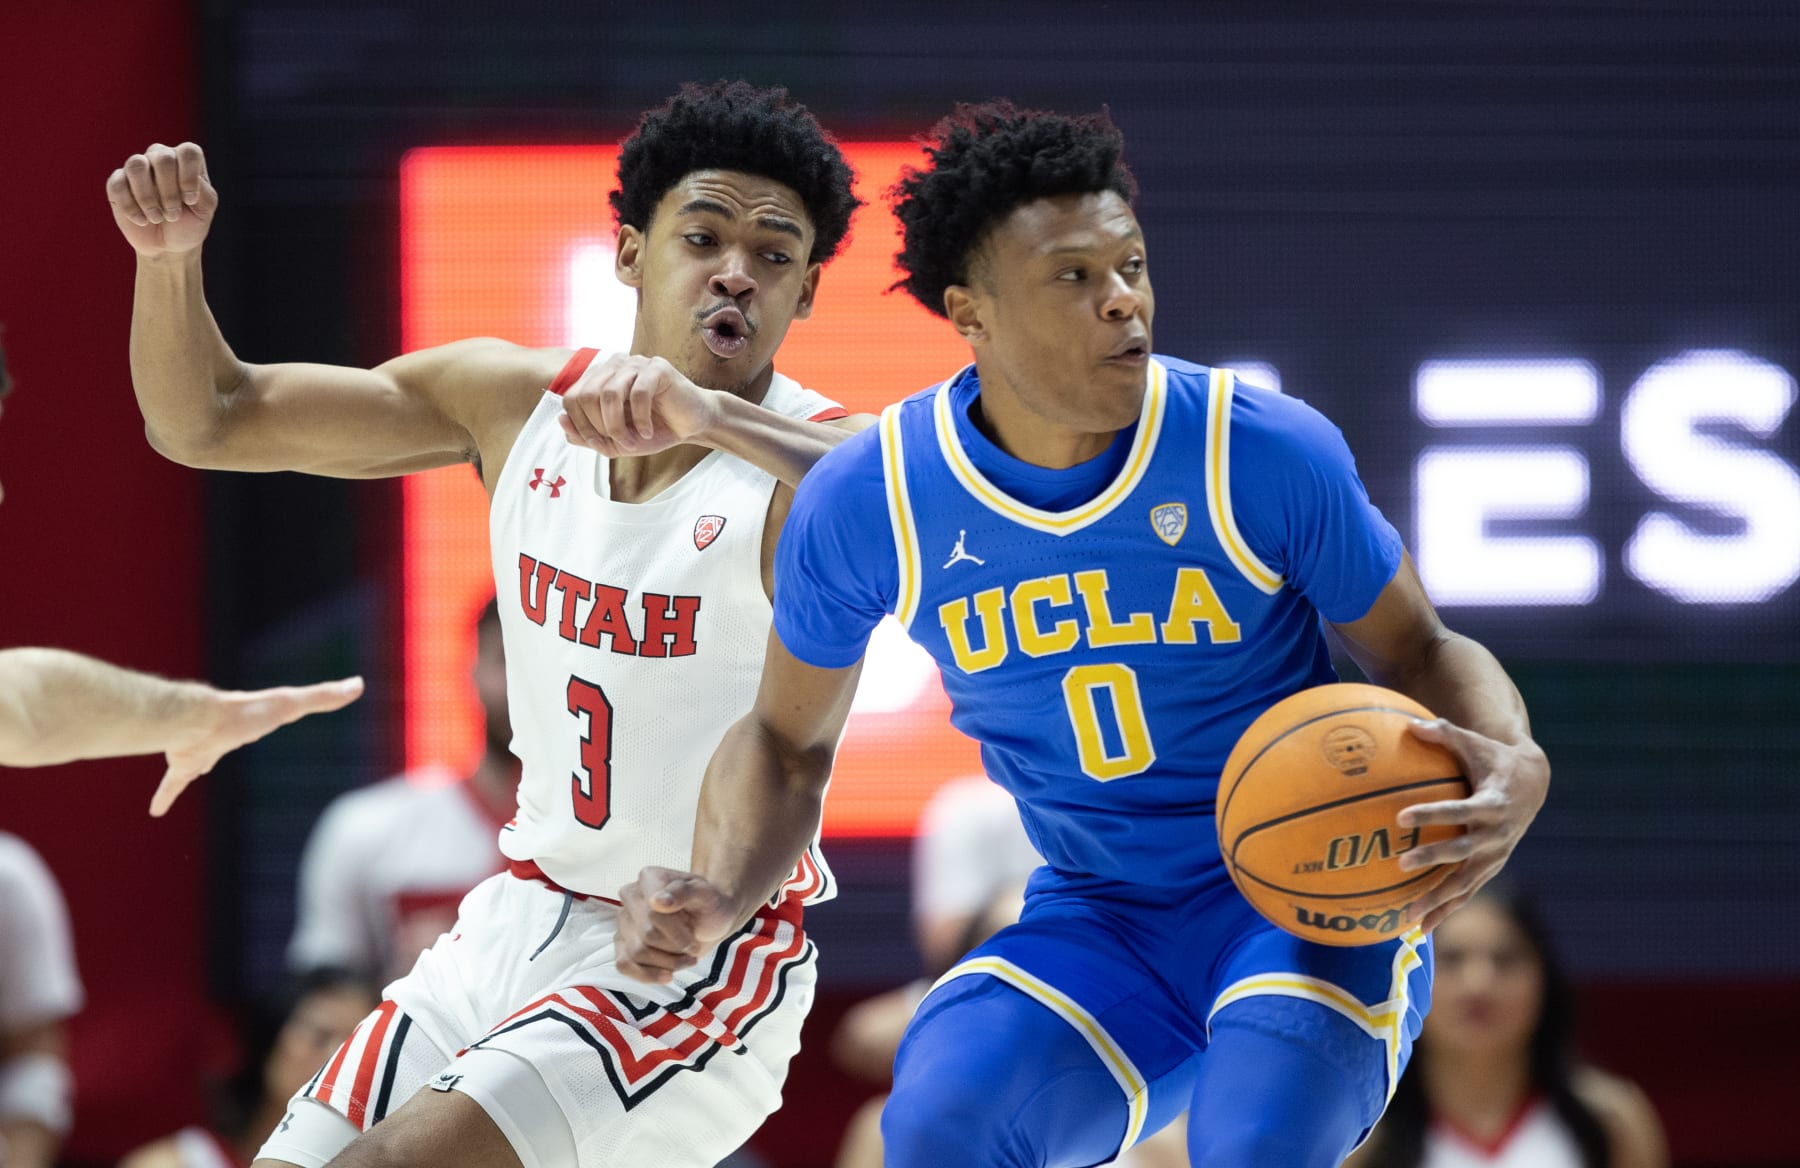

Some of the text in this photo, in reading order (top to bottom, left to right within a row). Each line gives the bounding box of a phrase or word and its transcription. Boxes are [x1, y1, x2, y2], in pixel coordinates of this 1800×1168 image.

[1216, 348, 1800, 605] ES
[518, 552, 702, 658] UTAH
[938, 567, 1241, 675] UCLA
[566, 674, 613, 830] 3
[1061, 663, 1157, 783] 0
